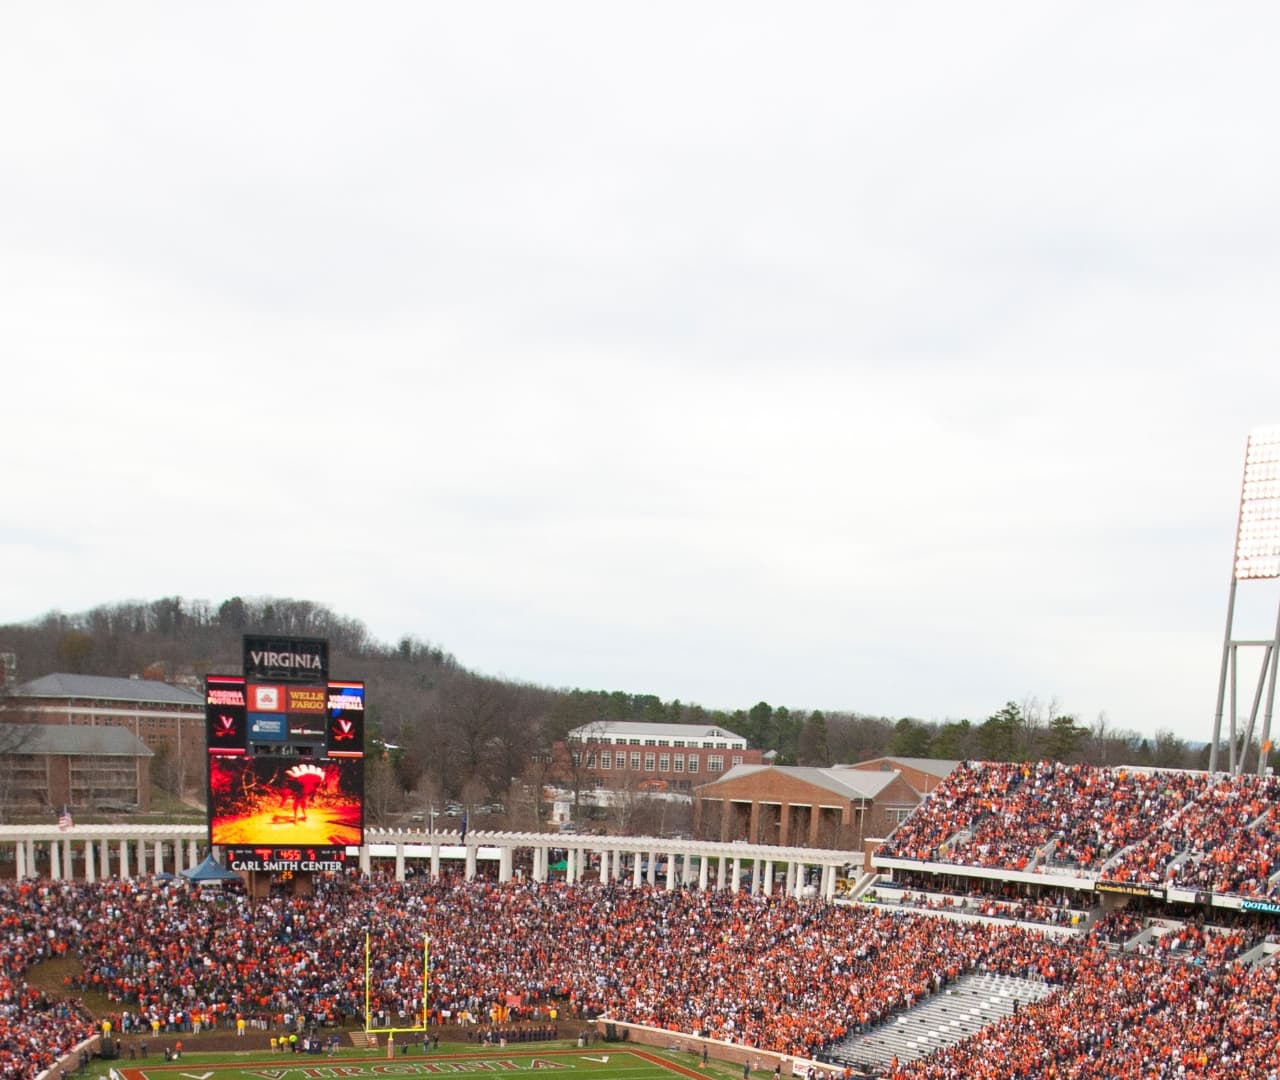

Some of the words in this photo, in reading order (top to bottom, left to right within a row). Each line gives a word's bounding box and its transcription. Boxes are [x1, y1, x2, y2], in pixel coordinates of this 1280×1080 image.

[250, 651, 322, 669] VIRGINIA
[209, 690, 243, 699] VIRGINIA
[290, 692, 324, 700] WELLS
[329, 695, 361, 703] VIRGINIA
[208, 697, 245, 706] FOOTBALL
[291, 701, 324, 709] FARGO
[328, 702, 364, 710] FOOTBALL
[232, 861, 260, 871] CARL
[263, 861, 298, 871] SMITH
[301, 861, 342, 871] CENTER
[1241, 901, 1280, 912] FOOTBALL
[240, 1059, 576, 1080] VIRGINIA
